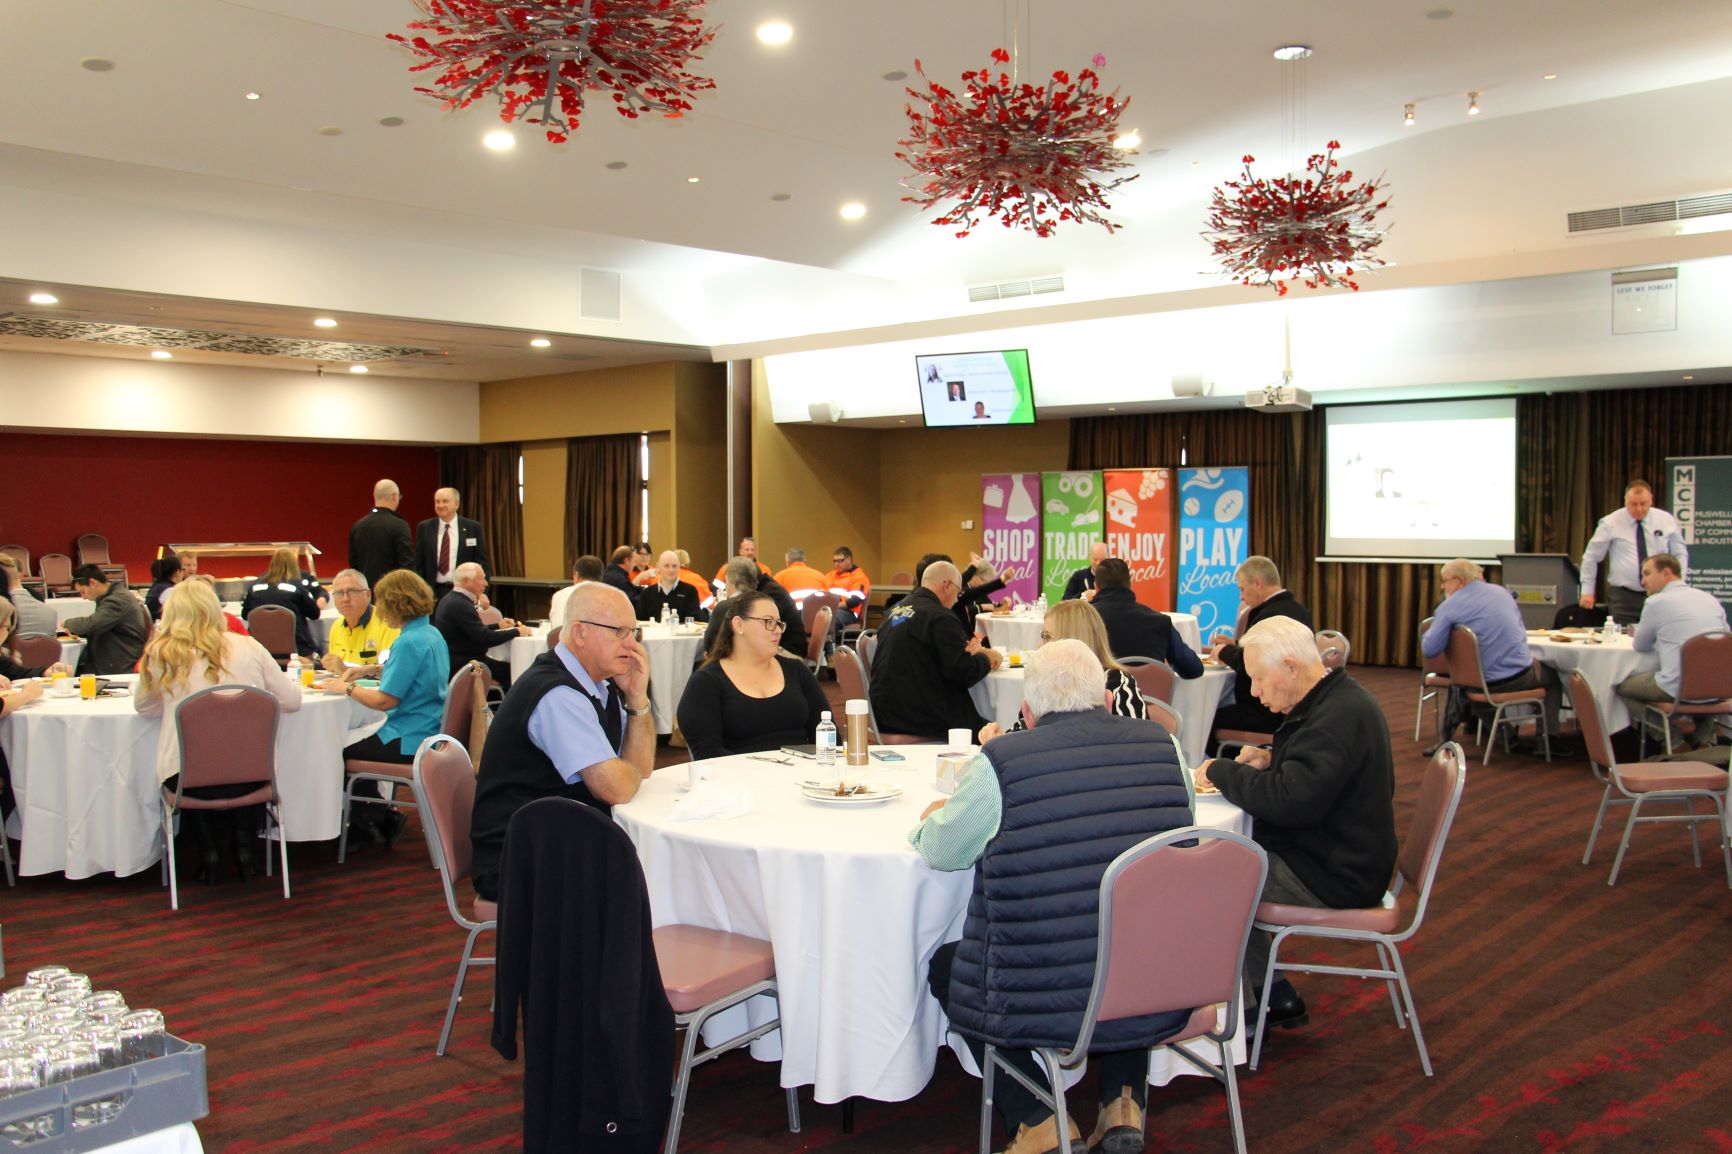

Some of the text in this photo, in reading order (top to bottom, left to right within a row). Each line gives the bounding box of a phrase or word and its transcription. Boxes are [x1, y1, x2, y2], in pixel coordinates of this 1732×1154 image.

[1647, 283, 1673, 291] FORGET
[983, 529, 1035, 562] SHOP
[1180, 528, 1243, 566] PLAY
[1695, 528, 1706, 536] OF
[1107, 533, 1166, 562] ENJOY
[1179, 563, 1241, 595] Local
